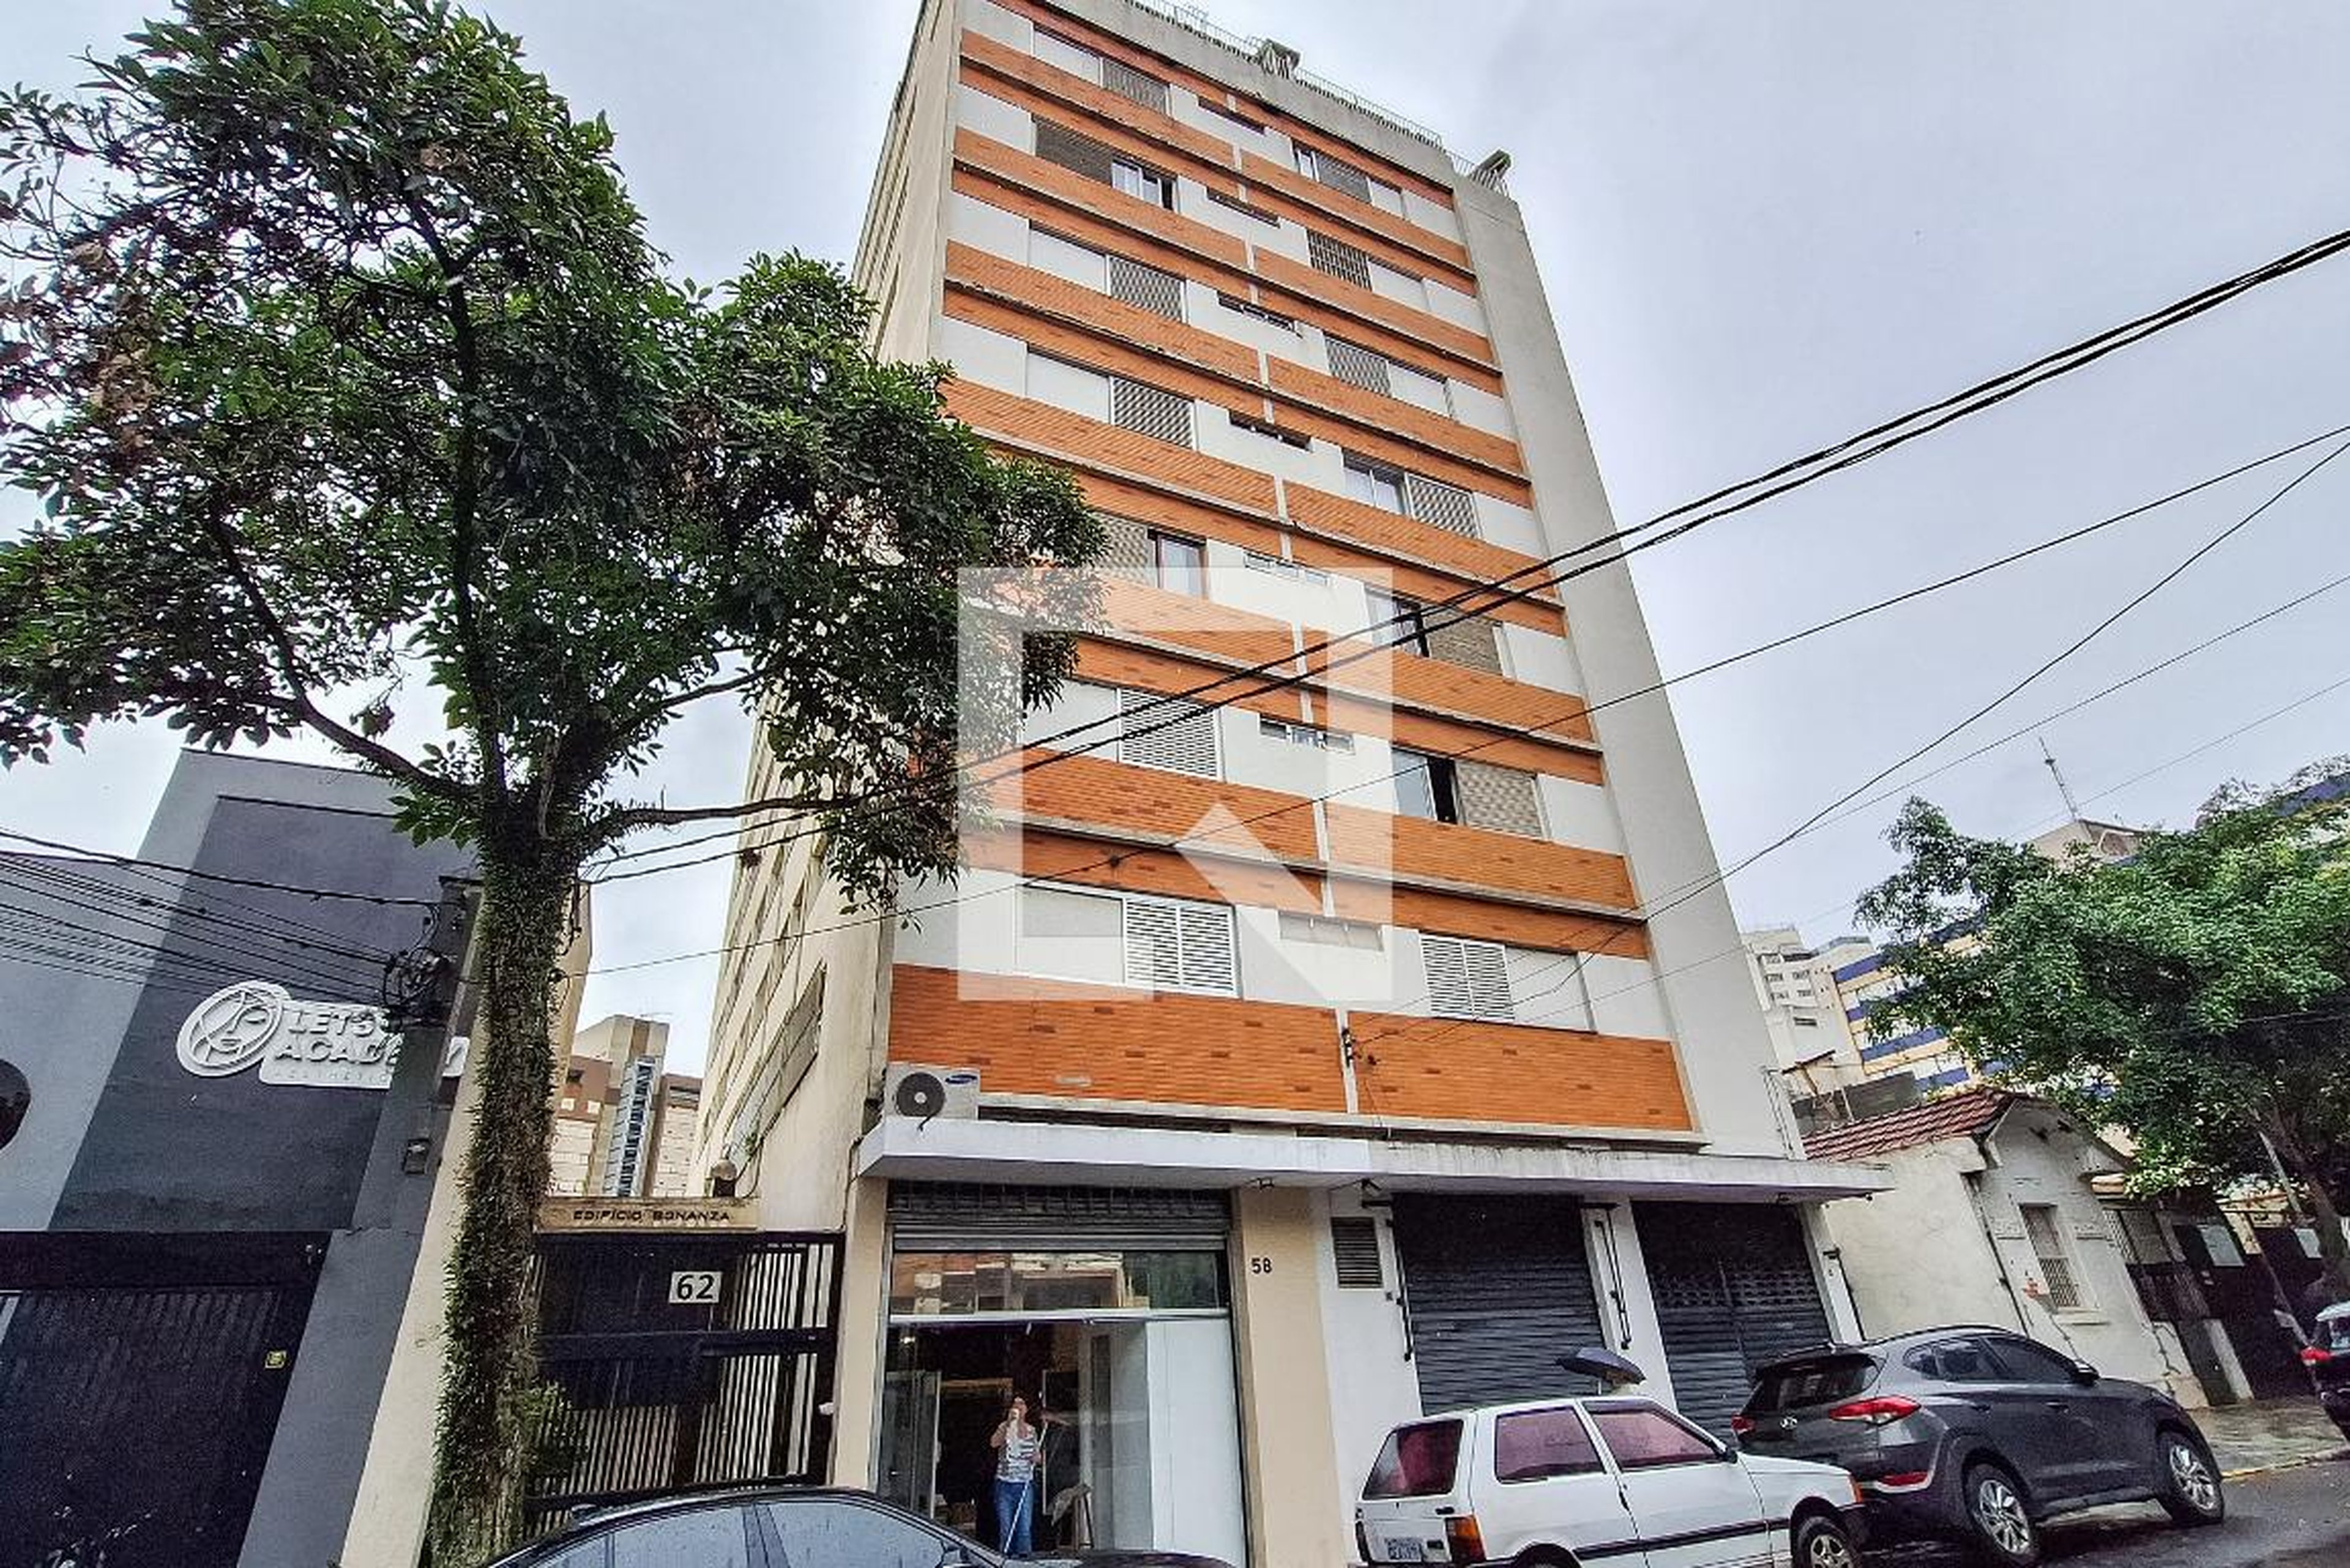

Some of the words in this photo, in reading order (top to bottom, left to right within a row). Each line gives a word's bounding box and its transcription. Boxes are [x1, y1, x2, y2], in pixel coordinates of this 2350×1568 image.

[275, 1037, 404, 1065] ACAD
[652, 1210, 729, 1221] BONANZA
[1251, 1258, 1272, 1274] 58
[677, 1275, 714, 1299] 62
